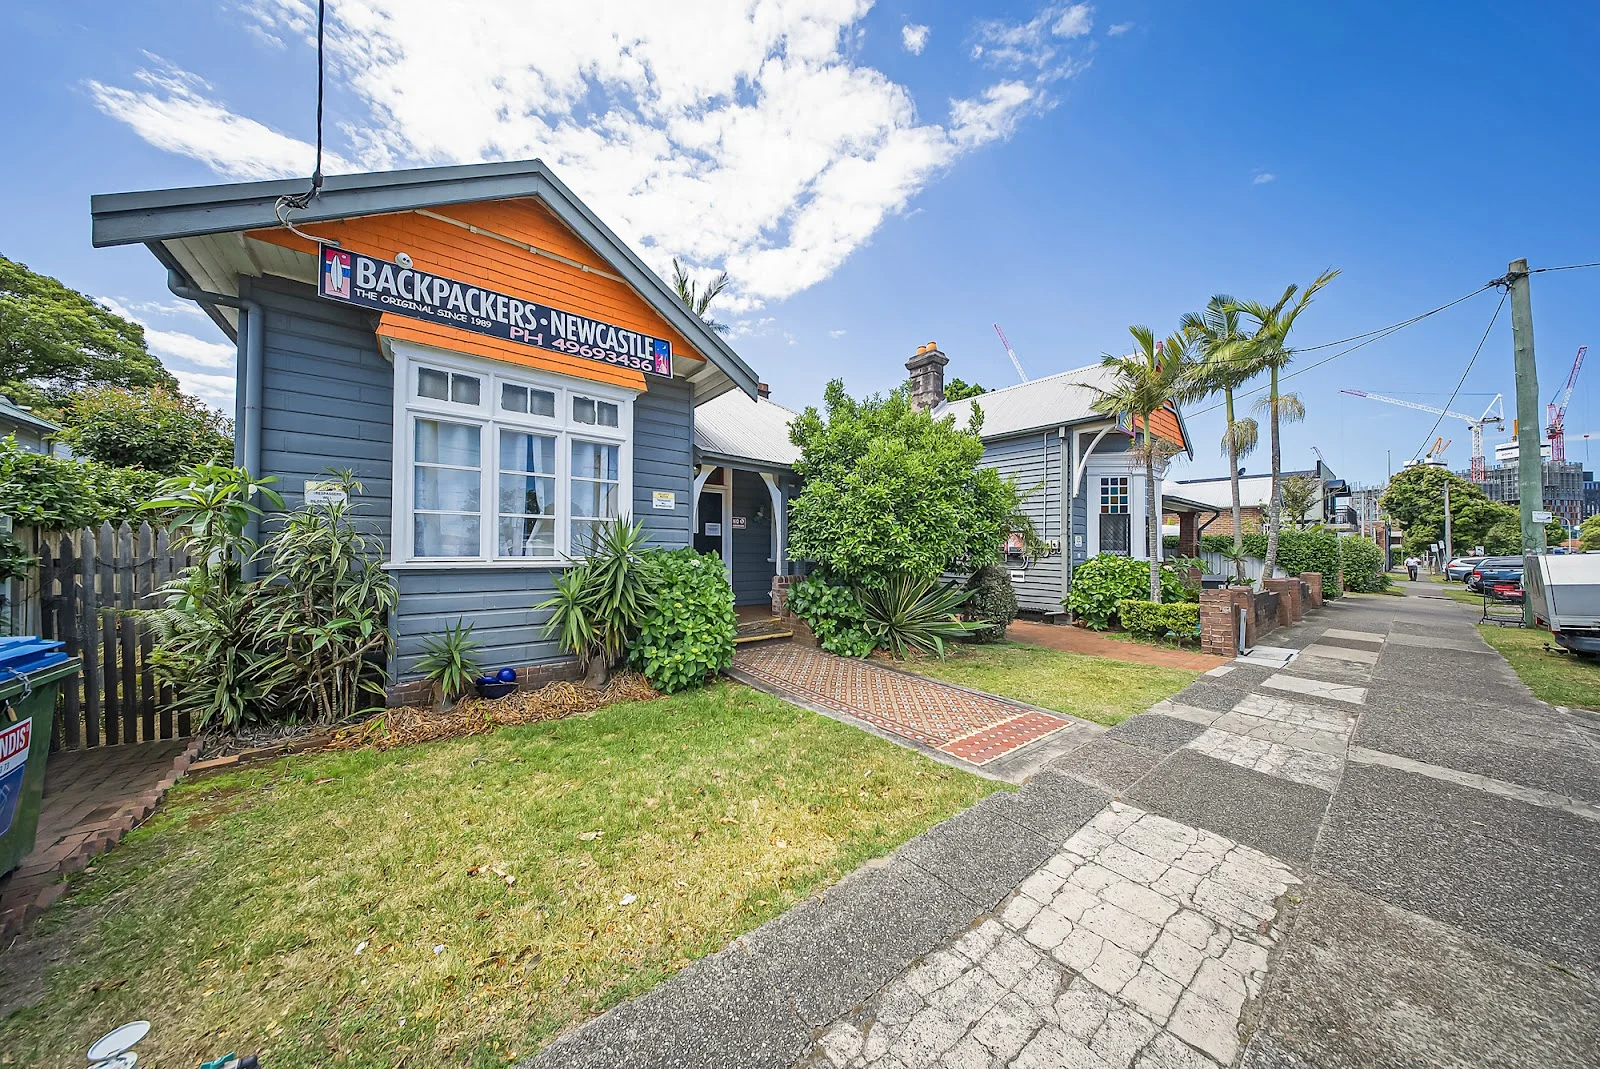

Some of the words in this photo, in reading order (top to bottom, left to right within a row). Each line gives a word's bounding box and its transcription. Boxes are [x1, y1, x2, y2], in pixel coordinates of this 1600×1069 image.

[354, 287, 378, 300] THE
[381, 295, 434, 315] ORIGINAL
[437, 309, 467, 322] SINCE
[470, 317, 492, 328] 1989
[356, 257, 537, 330] BACKPACKERS
[551, 310, 654, 361] NEWCASTLE
[510, 326, 543, 346] PH
[552, 338, 653, 372] 49693436
